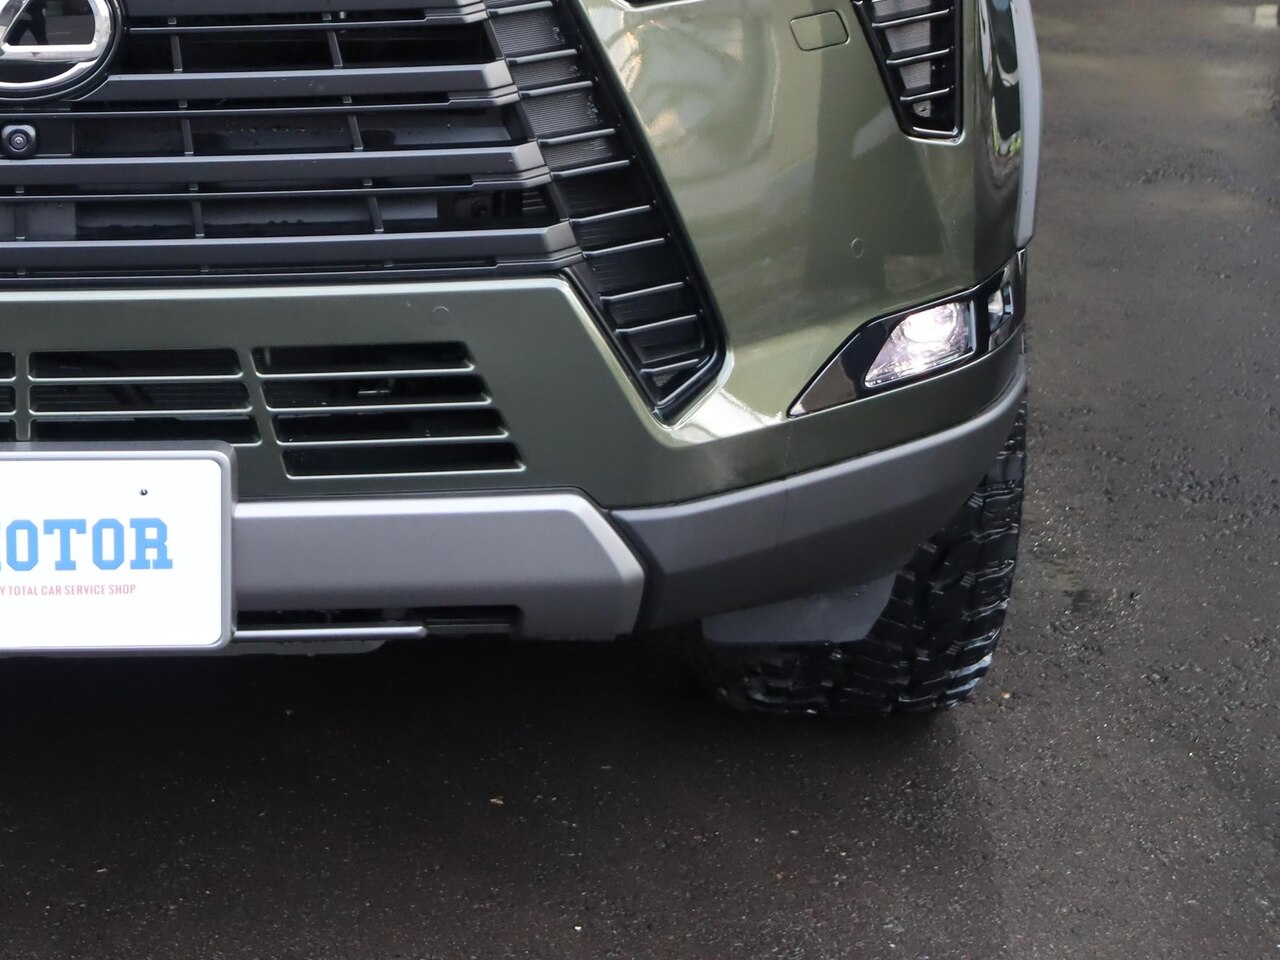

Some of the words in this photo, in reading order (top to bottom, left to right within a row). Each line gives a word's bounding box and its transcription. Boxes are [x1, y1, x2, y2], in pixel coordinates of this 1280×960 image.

[8, 585, 39, 596] TOTAL
[41, 584, 62, 596] CAR
[64, 584, 106, 595] SERVICE
[108, 583, 136, 595] SHOP
